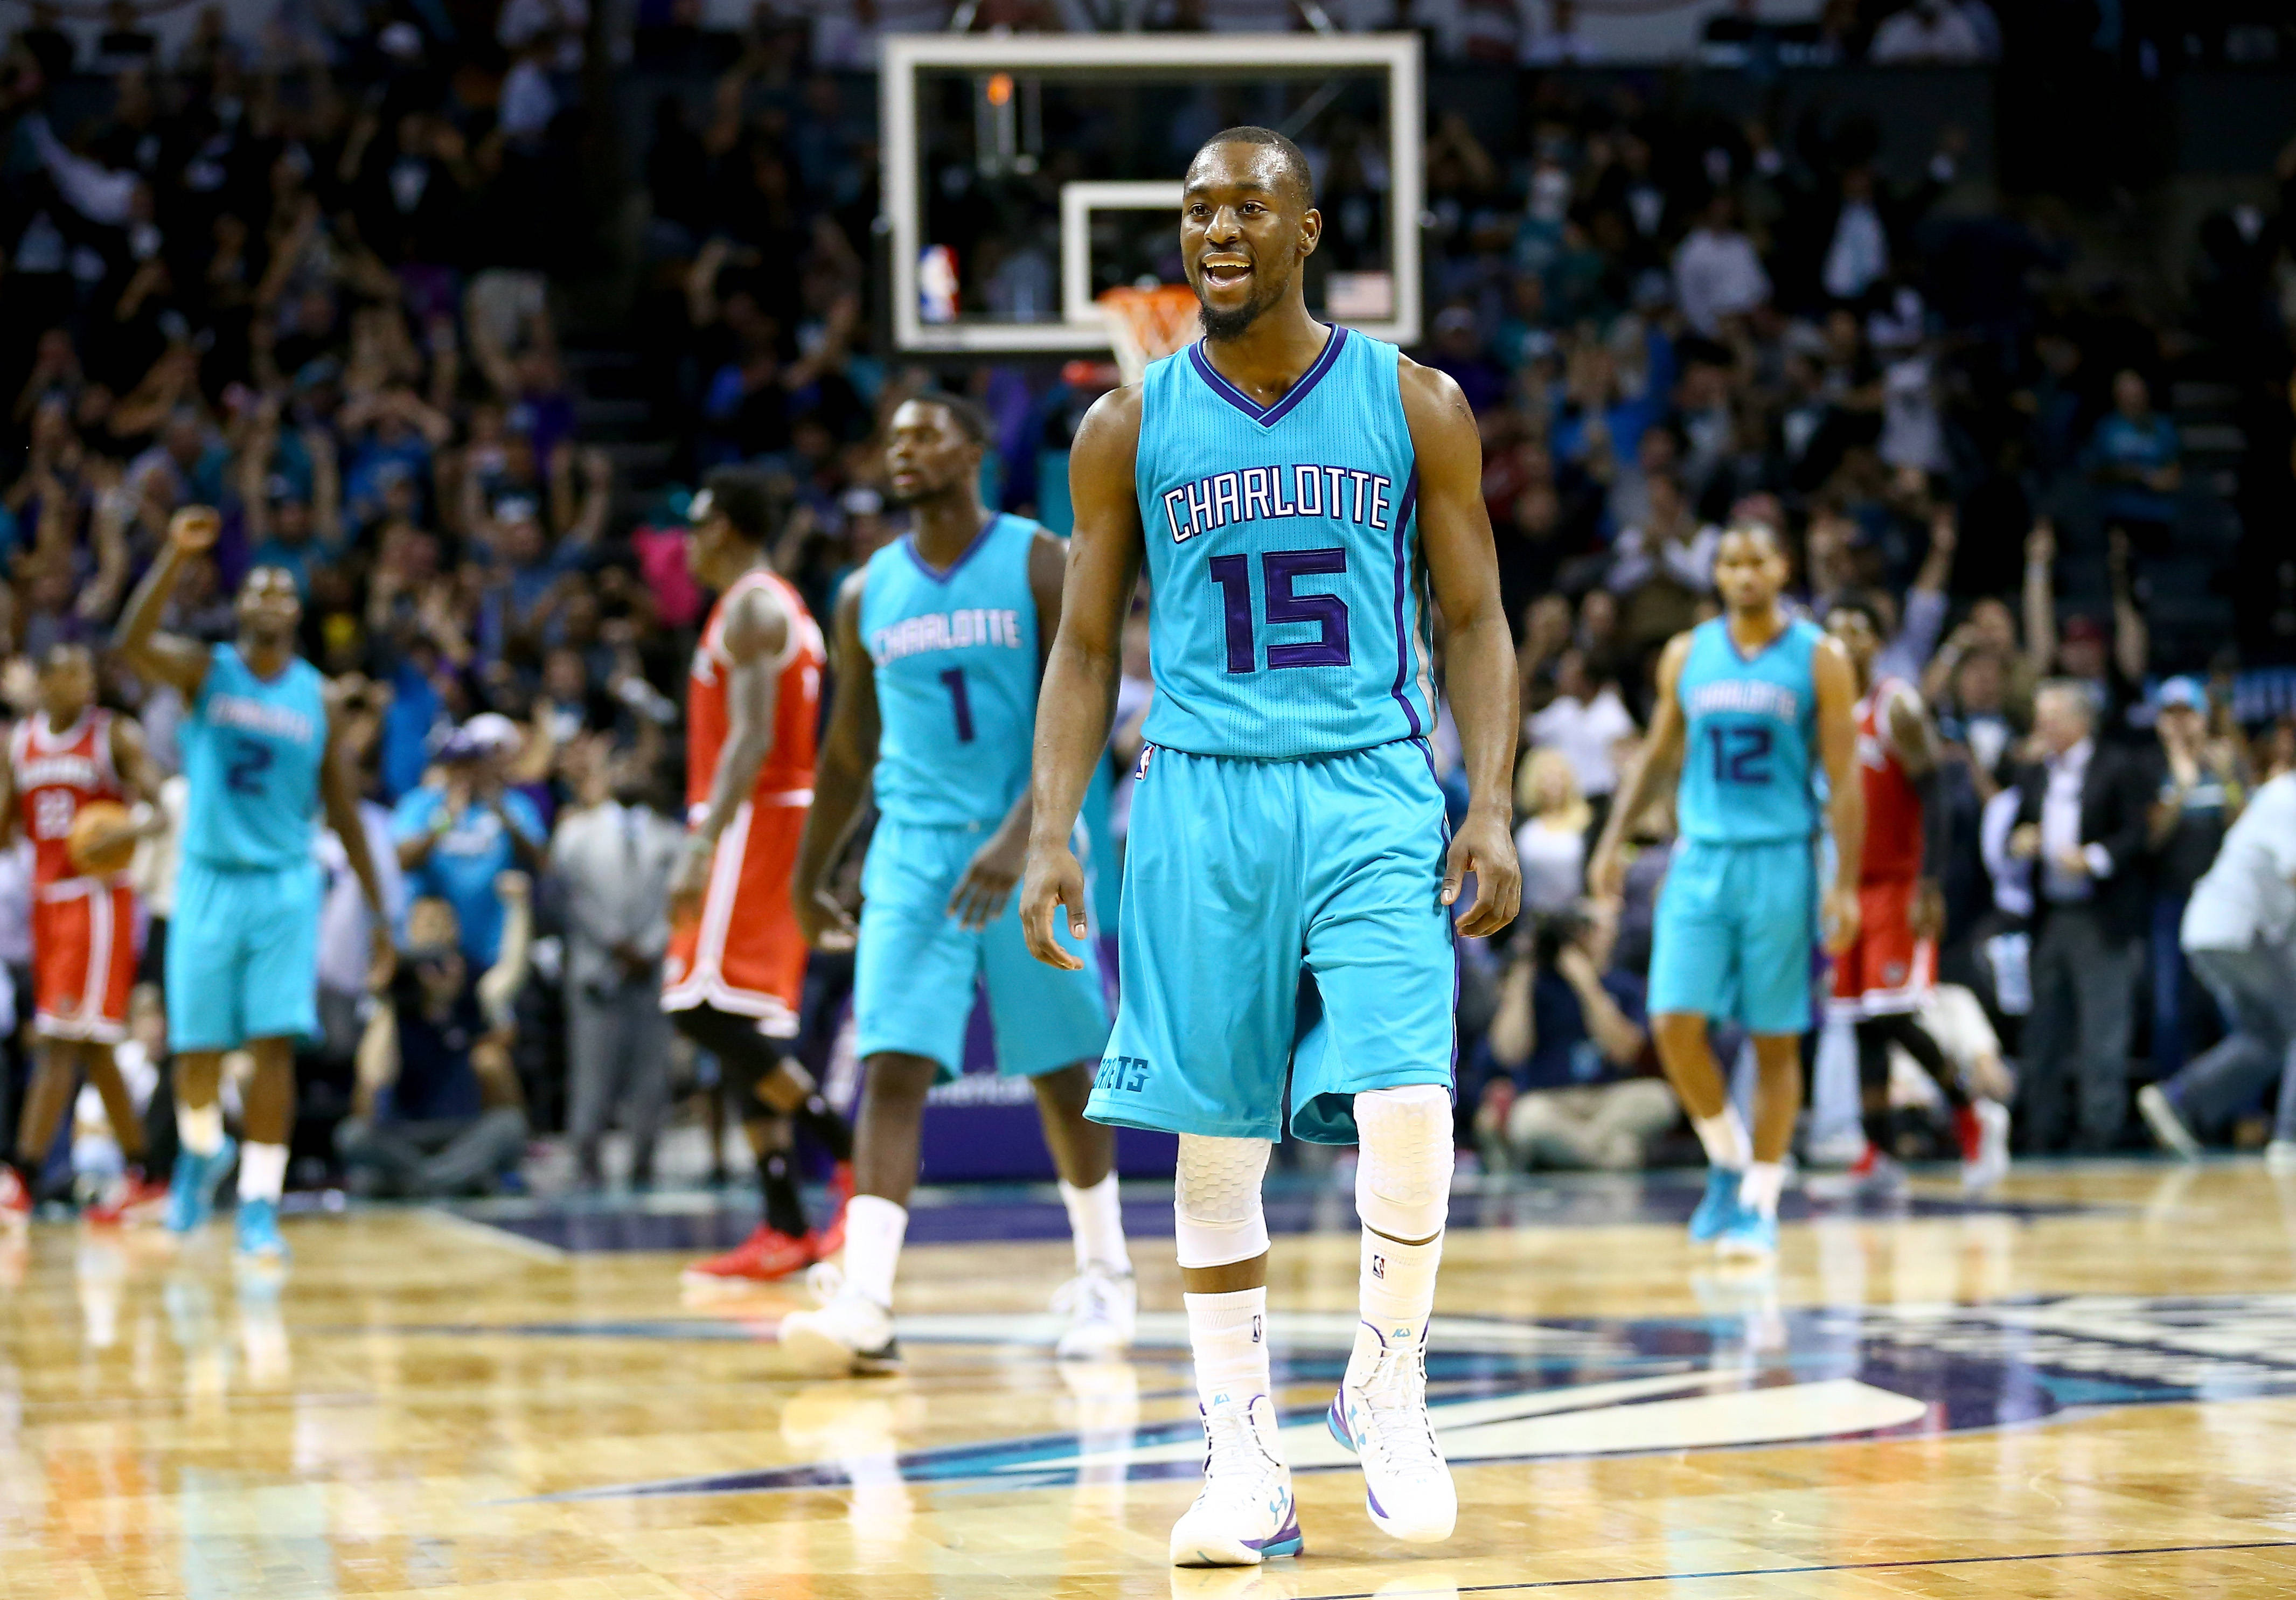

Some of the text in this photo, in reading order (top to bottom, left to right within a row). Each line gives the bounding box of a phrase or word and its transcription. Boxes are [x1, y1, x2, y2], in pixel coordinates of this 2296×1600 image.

[1162, 464, 1391, 545] CHARLOTTE
[871, 609, 1021, 667] CHARLOTTE
[1209, 547, 1351, 674] 15
[940, 667, 974, 743] 1
[227, 738, 273, 795] 2
[1708, 726, 1772, 782] 12
